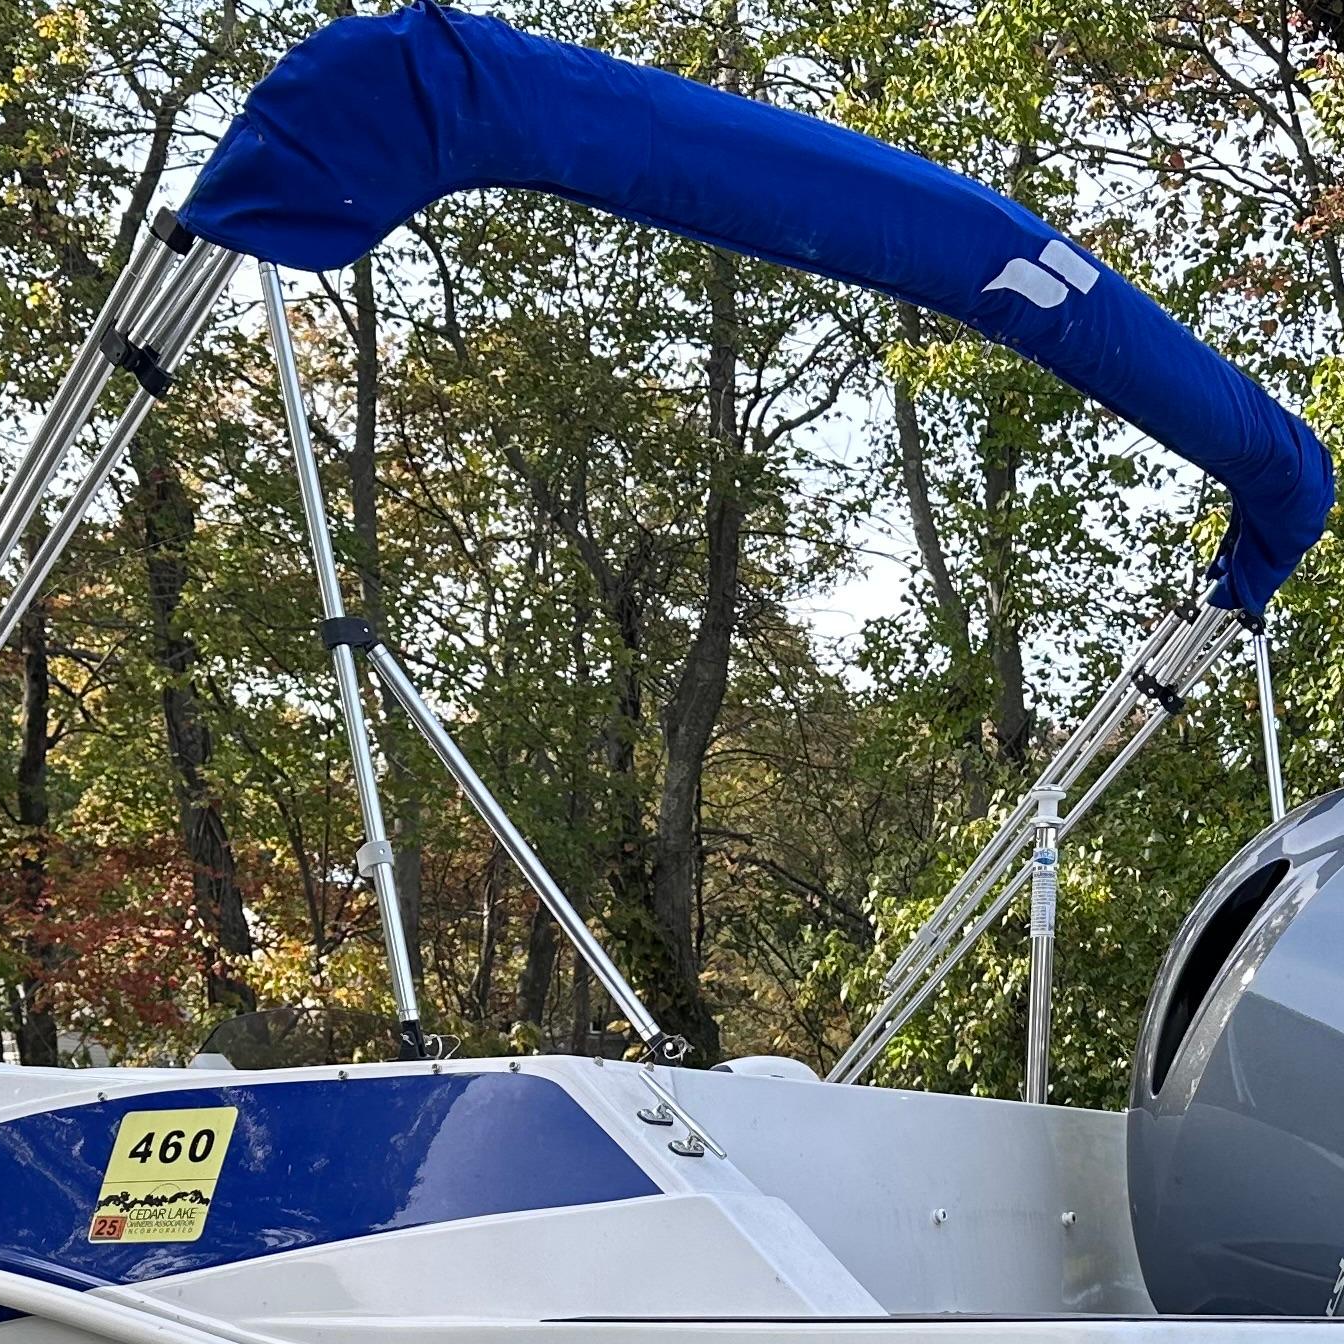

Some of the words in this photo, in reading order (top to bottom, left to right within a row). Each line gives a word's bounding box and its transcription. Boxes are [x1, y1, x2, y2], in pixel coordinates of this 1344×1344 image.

[128, 1129, 215, 1164] 460
[128, 1208, 167, 1221] CEDAR
[168, 1207, 198, 1220] LAKE
[94, 1219, 120, 1237] 25
